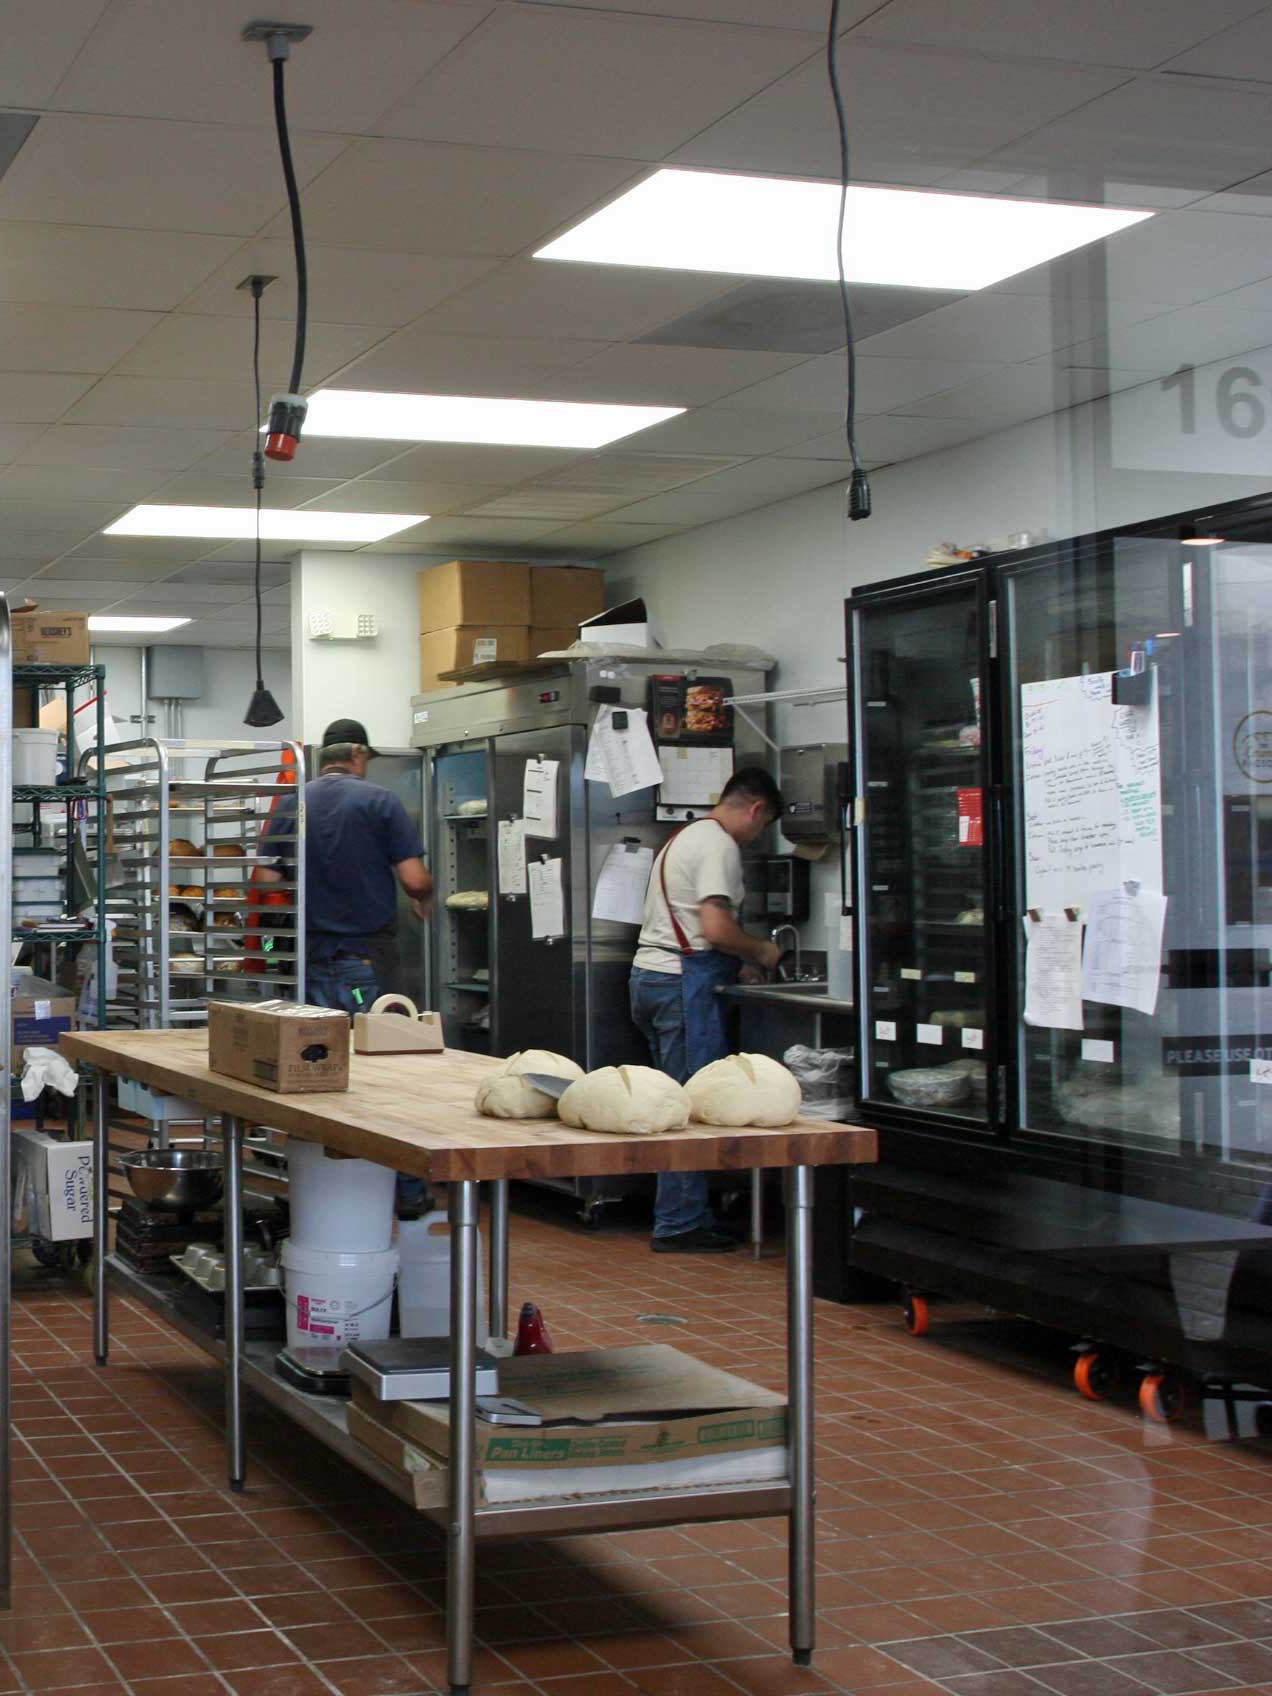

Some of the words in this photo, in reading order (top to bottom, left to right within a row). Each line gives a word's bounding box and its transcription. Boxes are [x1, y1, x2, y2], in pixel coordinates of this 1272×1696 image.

[1160, 363, 1272, 439] 16
[1166, 1049, 1221, 1064] PLEASE
[64, 1168, 77, 1211] Sugar
[77, 1155, 93, 1223] Podered
[491, 1447, 518, 1459] Pan
[521, 1447, 566, 1460] Liners
